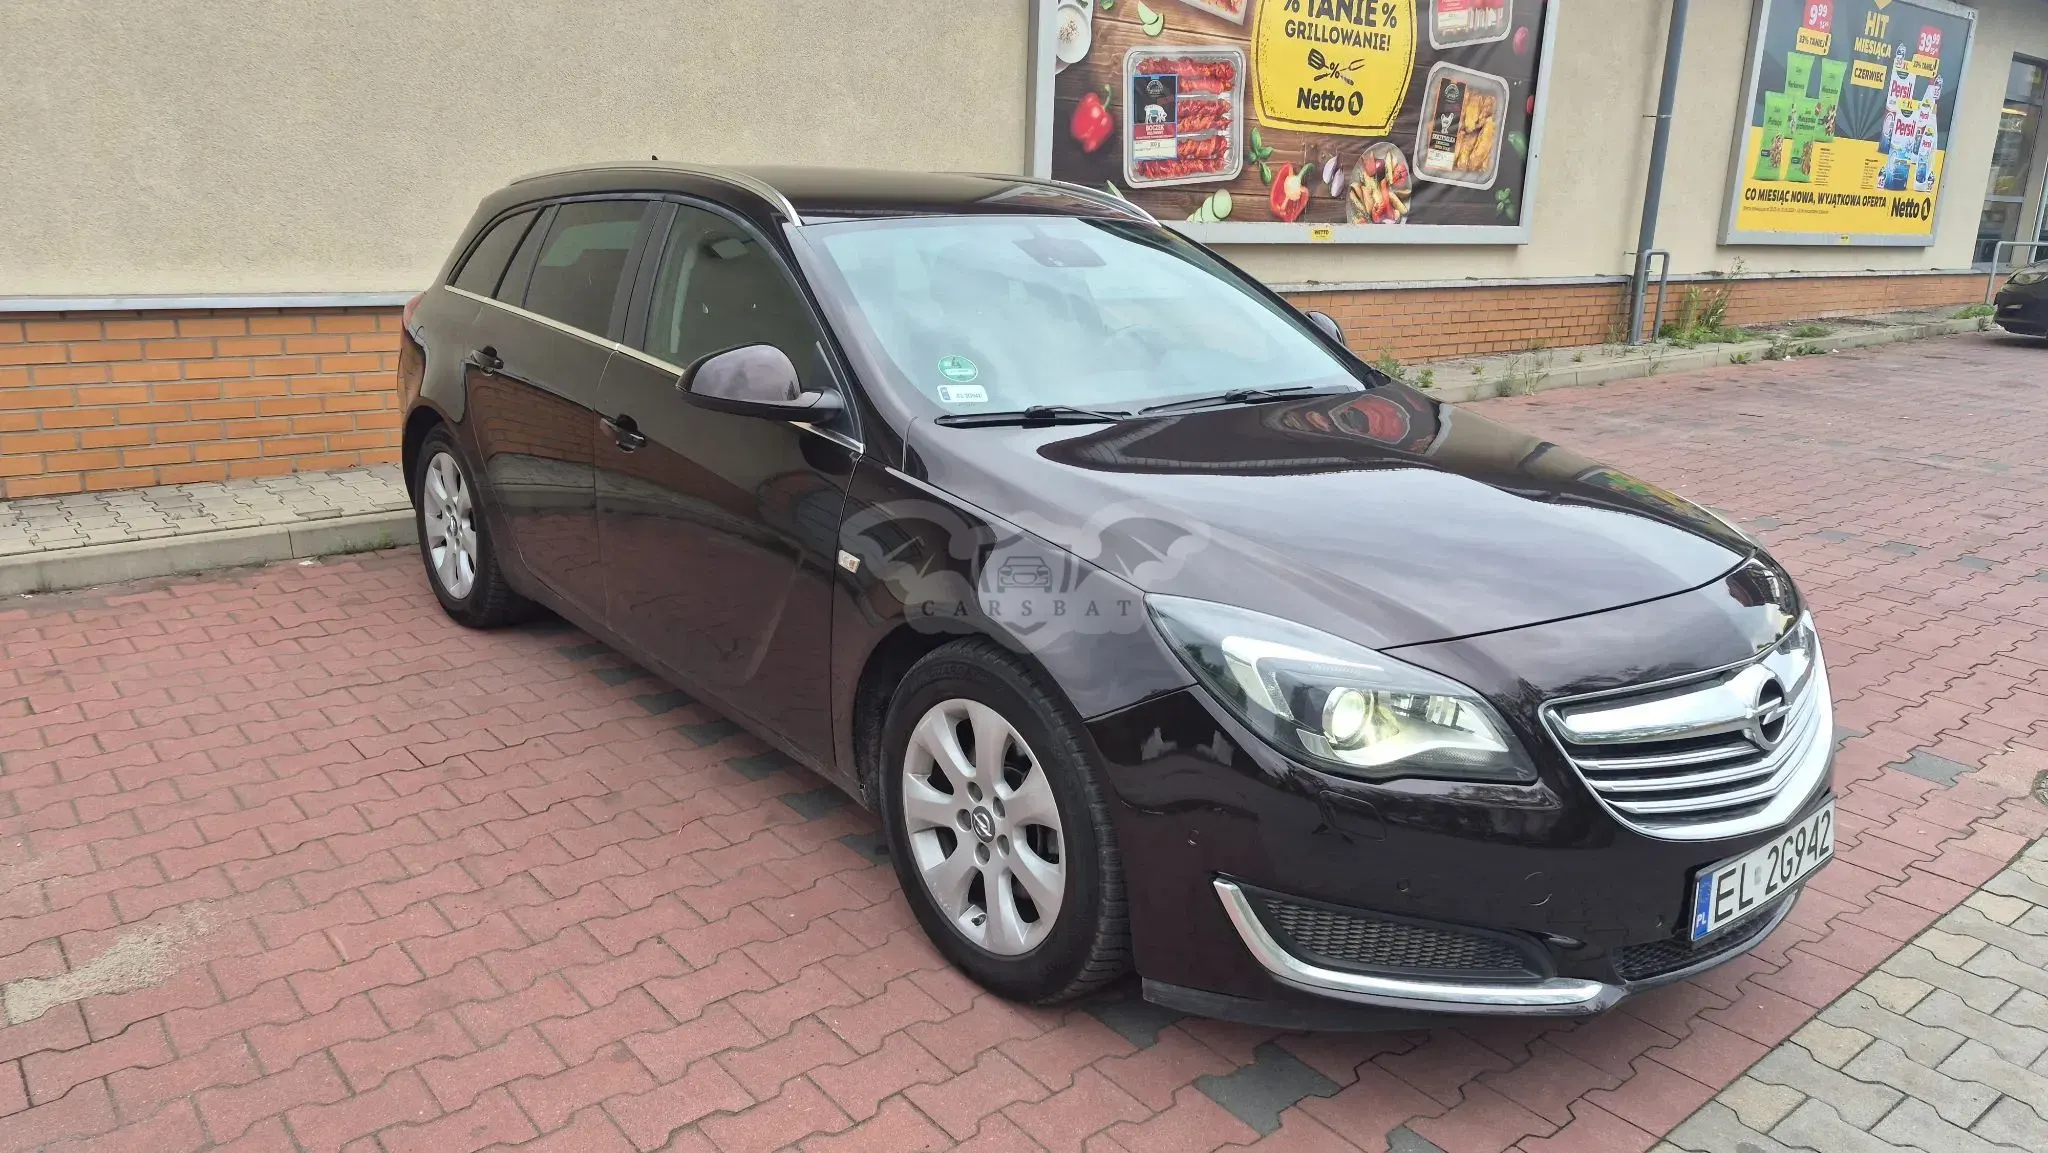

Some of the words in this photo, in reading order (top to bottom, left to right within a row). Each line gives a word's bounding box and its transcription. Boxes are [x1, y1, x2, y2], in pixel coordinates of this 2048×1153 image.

[1285, 19, 1391, 52] GRILLOWANIE!
[1864, 11, 1890, 39] HIT
[1854, 36, 1892, 60] MIESIĄCA
[1854, 67, 1884, 83] CZERWIEC
[1296, 87, 1345, 113] Netto
[1894, 118, 1917, 137] Persil
[1745, 187, 1757, 201] CO
[1757, 188, 1790, 206] MIESIĄC
[1790, 190, 1816, 205] NOWA,
[1817, 192, 1861, 208] WYJĄTKOWA
[1861, 195, 1887, 208] OFERTA
[1890, 196, 1920, 219] Netto
[1714, 862, 1754, 924] EL
[1765, 809, 1831, 896] 2G942
[1695, 913, 1707, 928] PL
